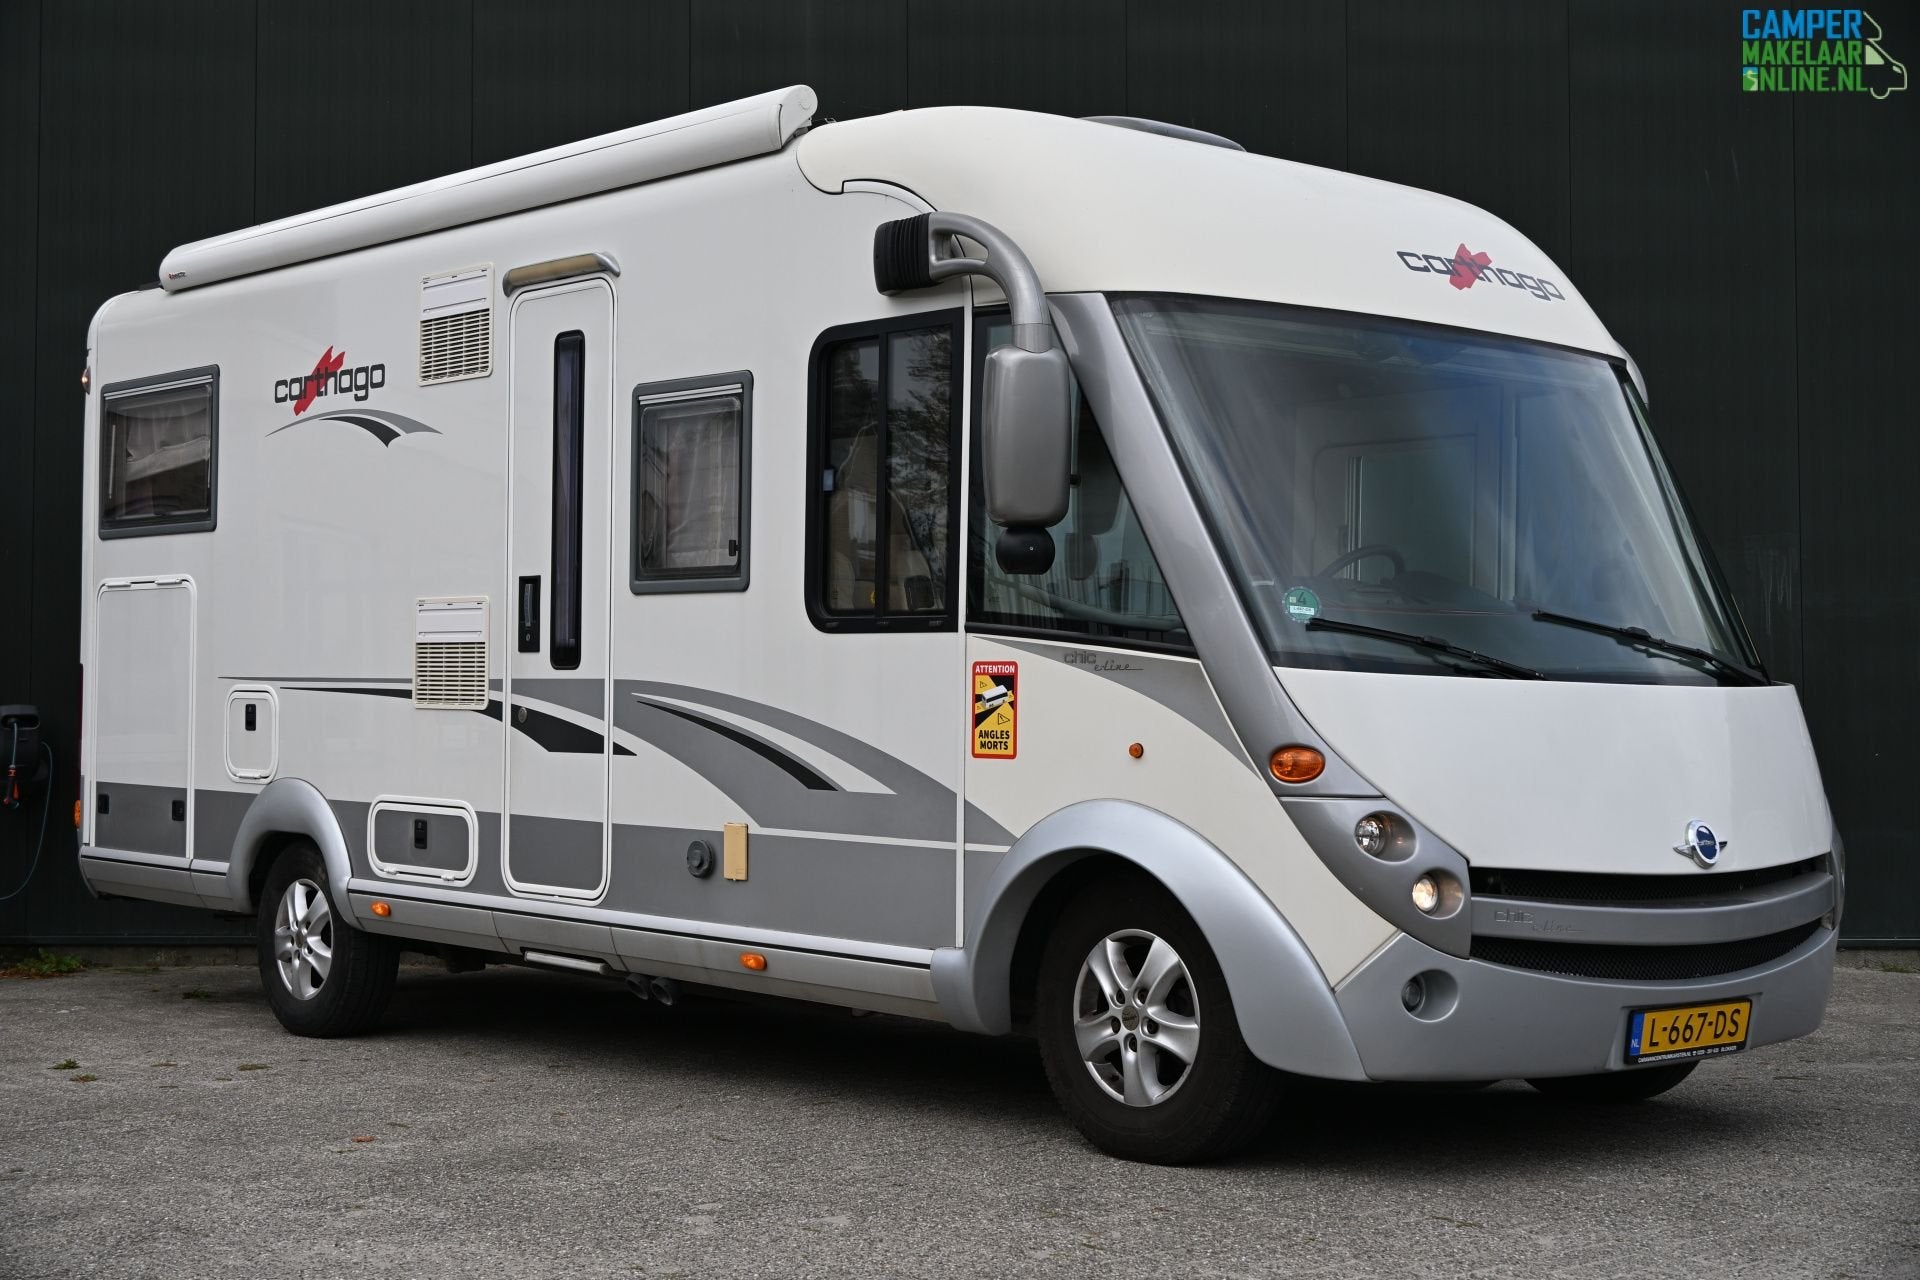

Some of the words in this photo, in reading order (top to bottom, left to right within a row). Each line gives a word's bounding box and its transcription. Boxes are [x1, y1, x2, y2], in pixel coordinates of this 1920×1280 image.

[1396, 251, 1566, 301] carthago
[274, 363, 385, 403] carthago
[1064, 650, 1097, 664] chic
[975, 664, 1015, 674] ATTENTION
[978, 730, 1010, 740] ANGLES
[979, 740, 1009, 751] MORTS
[1648, 1008, 1741, 1048] L-667-DS
[1630, 1038, 1640, 1049] NL
